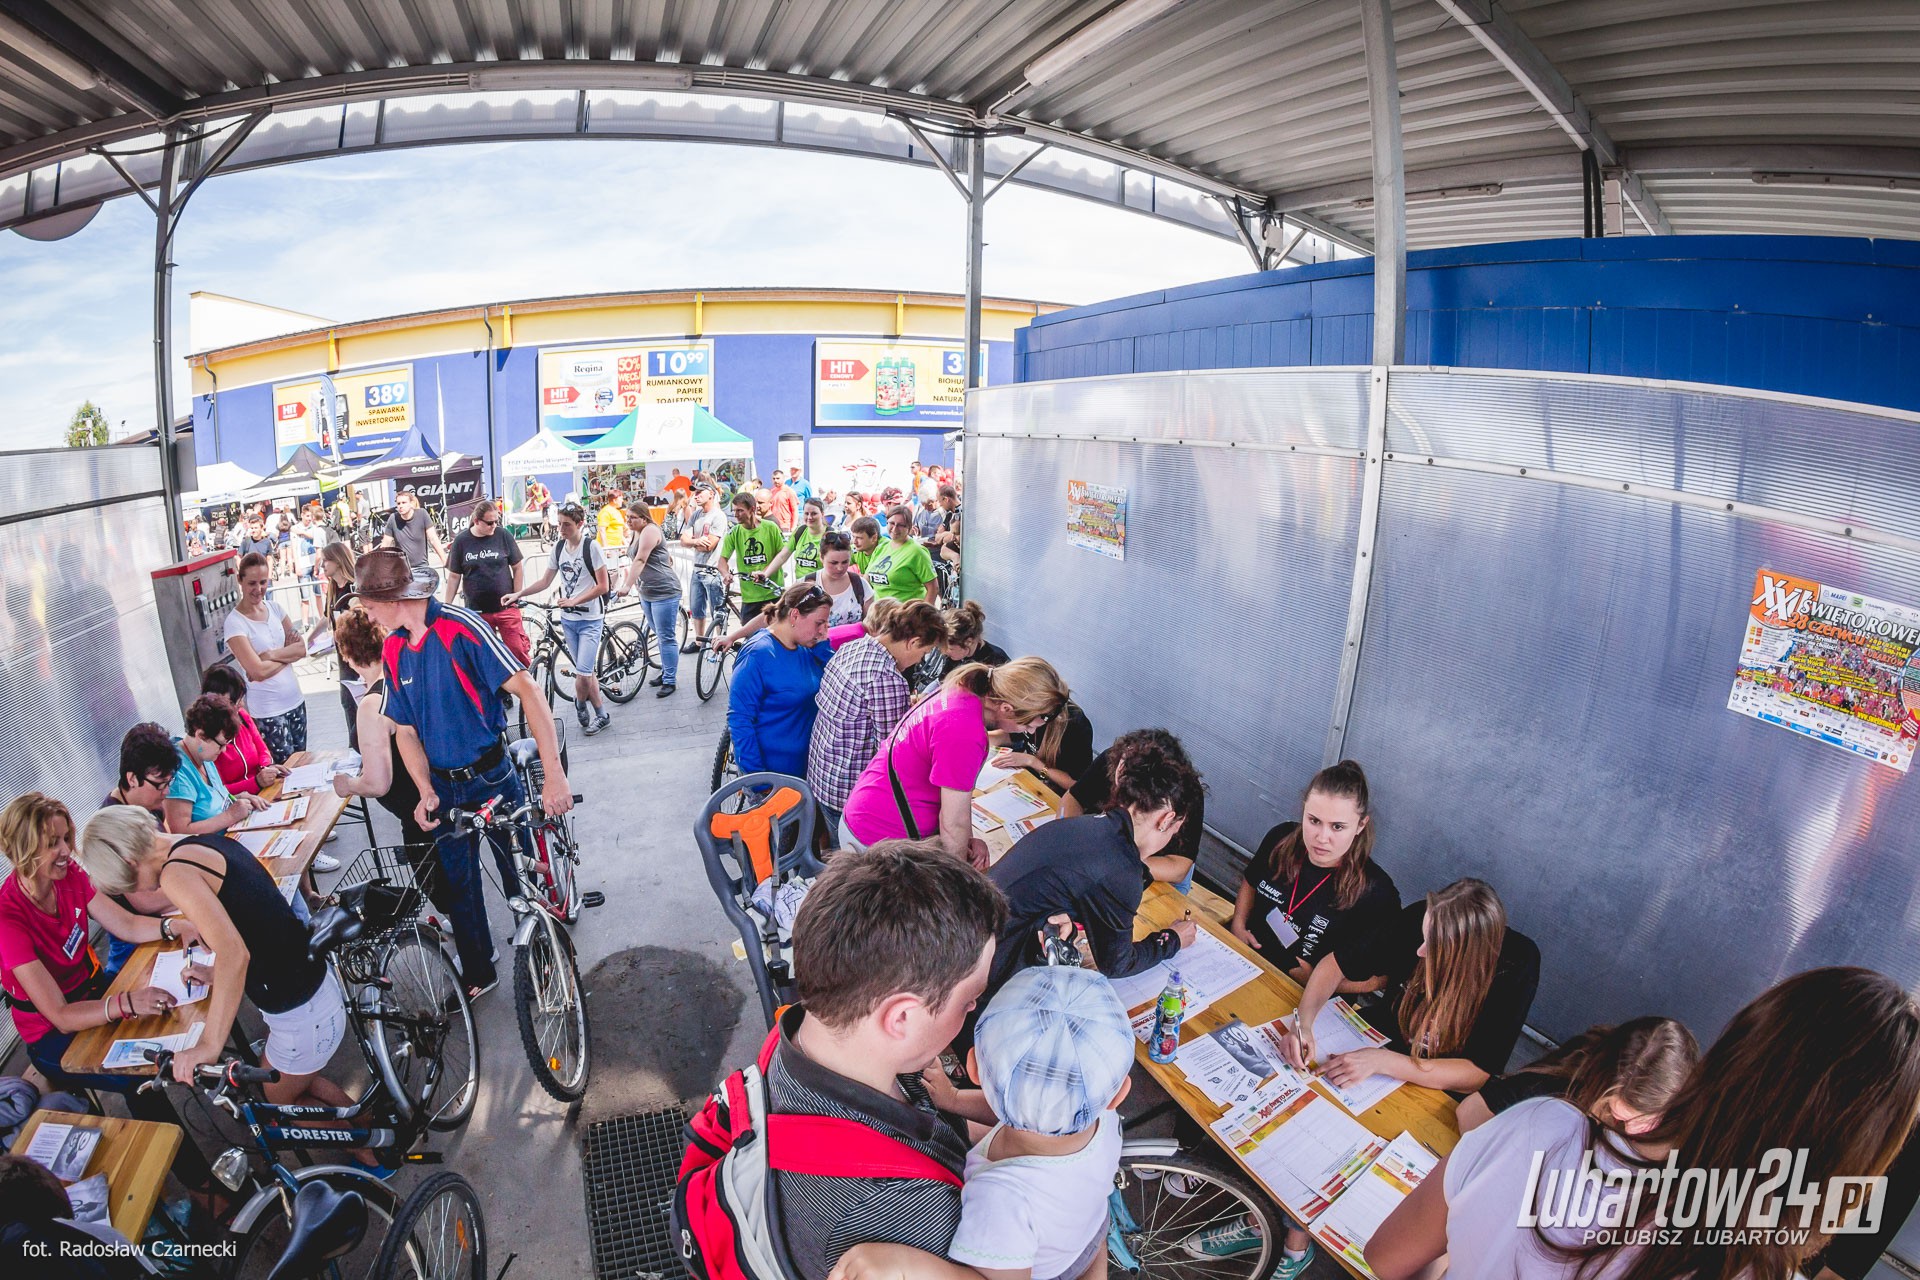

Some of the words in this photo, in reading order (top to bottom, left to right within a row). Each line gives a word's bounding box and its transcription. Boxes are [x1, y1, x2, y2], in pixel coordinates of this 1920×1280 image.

[574, 364, 603, 373] Regina
[618, 358, 640, 371] 50%
[830, 361, 855, 373] HIT
[646, 378, 703, 386] RUMIANKOWY
[368, 384, 405, 406] 389
[551, 388, 569, 399] HIT
[623, 395, 636, 407] 12
[282, 404, 298, 415] HIT
[368, 406, 405, 416] SPAWARKA
[355, 415, 405, 427] INWERTOROWA
[417, 465, 440, 473] GIANT
[744, 556, 766, 564] TSR
[797, 558, 817, 568] TSR
[868, 573, 888, 584] TSR
[1800, 594, 1867, 628] ŚWIĘTO
[1786, 612, 1809, 631] 28
[1853, 628, 1870, 639] 2015
[1864, 649, 1906, 667] LUBARTÓW
[281, 1128, 353, 1142] FORESTER
